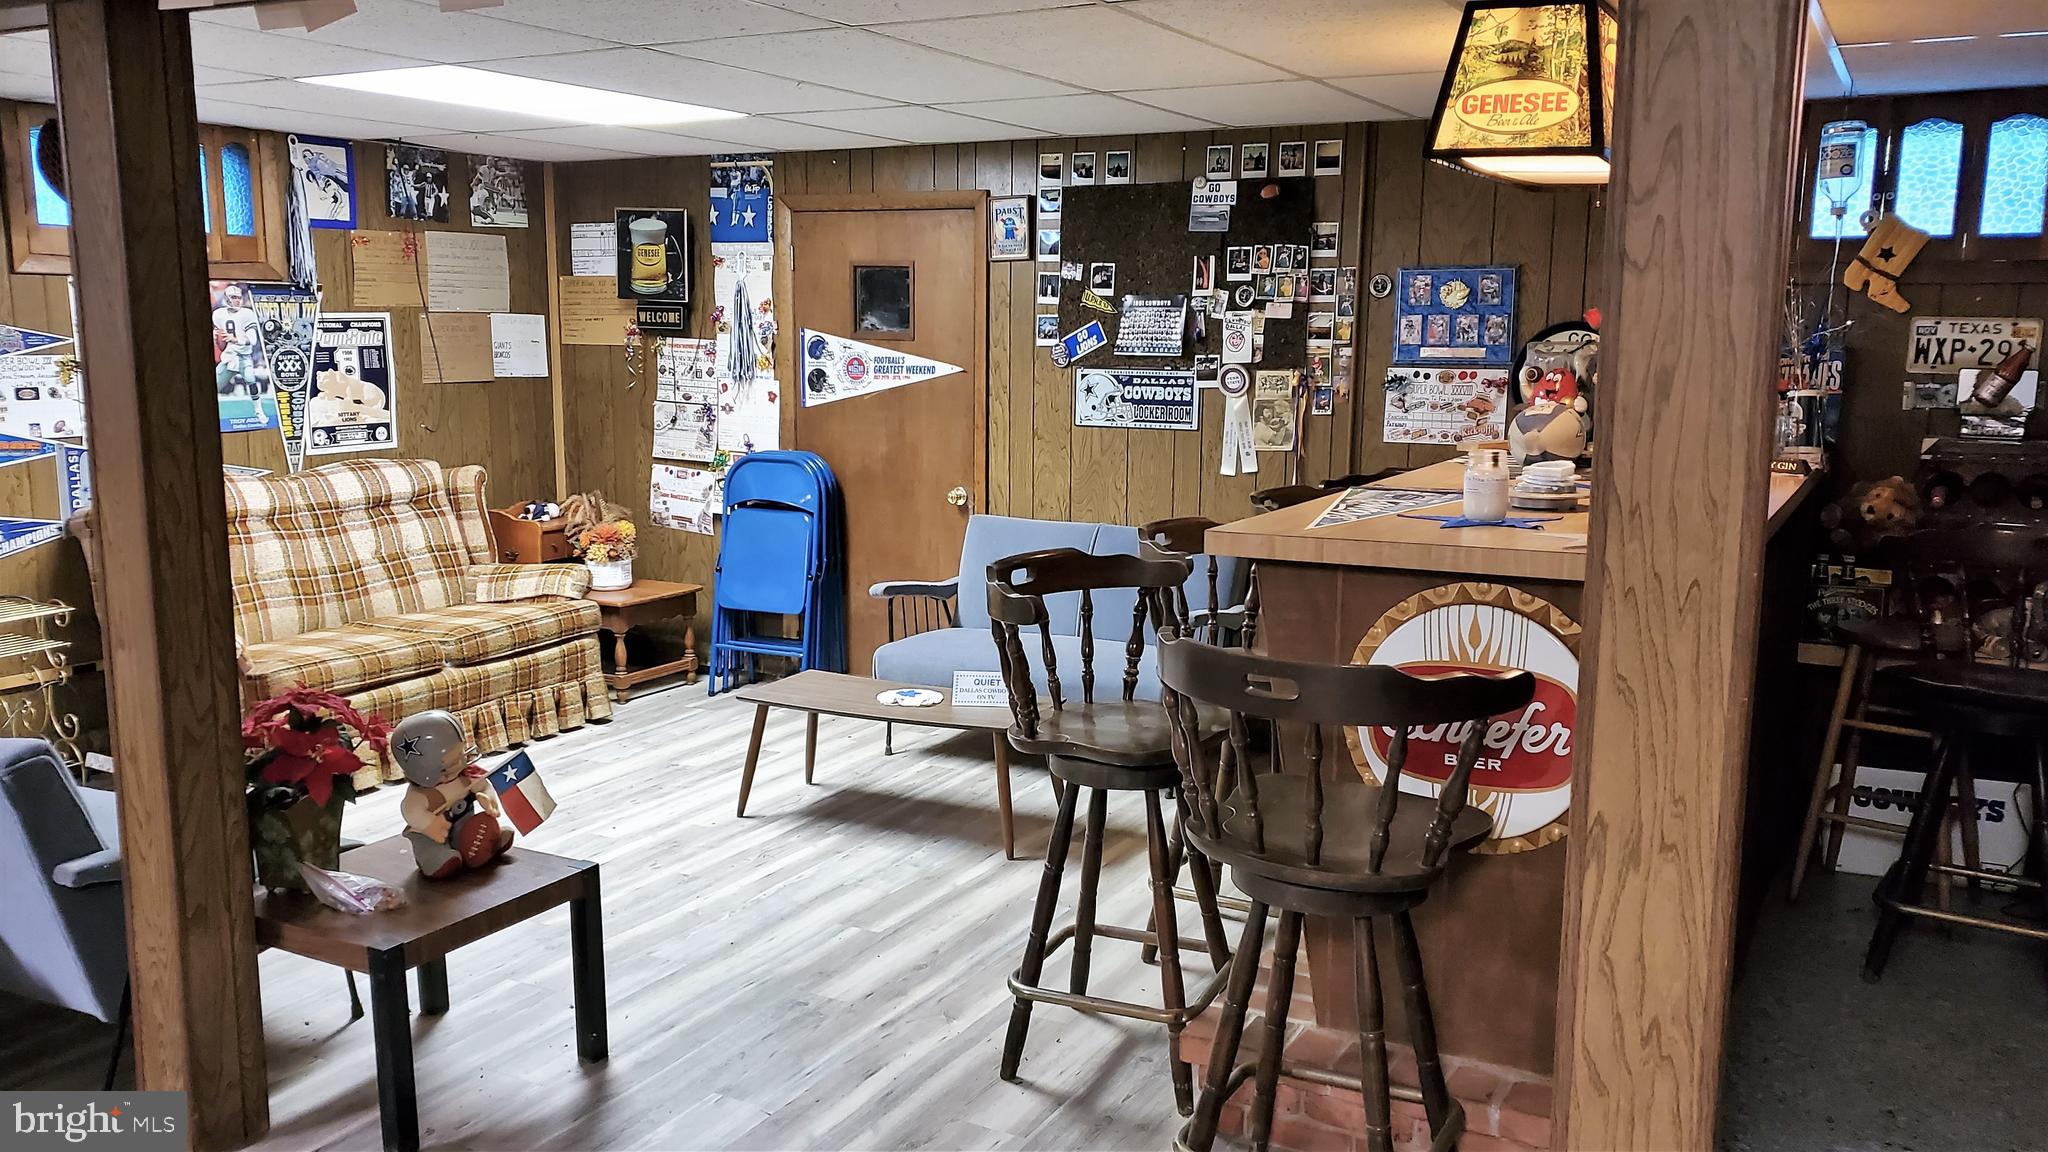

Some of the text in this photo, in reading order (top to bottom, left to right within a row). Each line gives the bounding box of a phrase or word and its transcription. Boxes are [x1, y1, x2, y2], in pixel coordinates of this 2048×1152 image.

[1462, 92, 1570, 115] GENESEE
[1487, 113, 1511, 127] Beer
[1520, 113, 1540, 126] Ale
[1208, 183, 1220, 192] GO
[1193, 194, 1235, 203] COWBOYS
[638, 248, 660, 258] GENESEE
[639, 311, 680, 324] WELCOME
[1076, 329, 1089, 341] GO
[1950, 322, 2003, 335] TEXAS
[494, 341, 512, 350] GIANTS
[1076, 335, 1098, 354] LIONS
[277, 360, 302, 372] XXX
[873, 356, 905, 364] FOOTBALL'S
[873, 365, 936, 375] GREATEST WEEKEND
[1133, 377, 1186, 385] DALLAS
[1124, 386, 1192, 401] COWBOYS
[292, 391, 306, 437] COWBOYS
[1134, 404, 1192, 421] LOCKER ROOM
[1777, 461, 1797, 470] GIN
[67, 455, 82, 508] DALLAS
[1444, 752, 1502, 772] BER
[1853, 785, 2005, 822] COWYS
